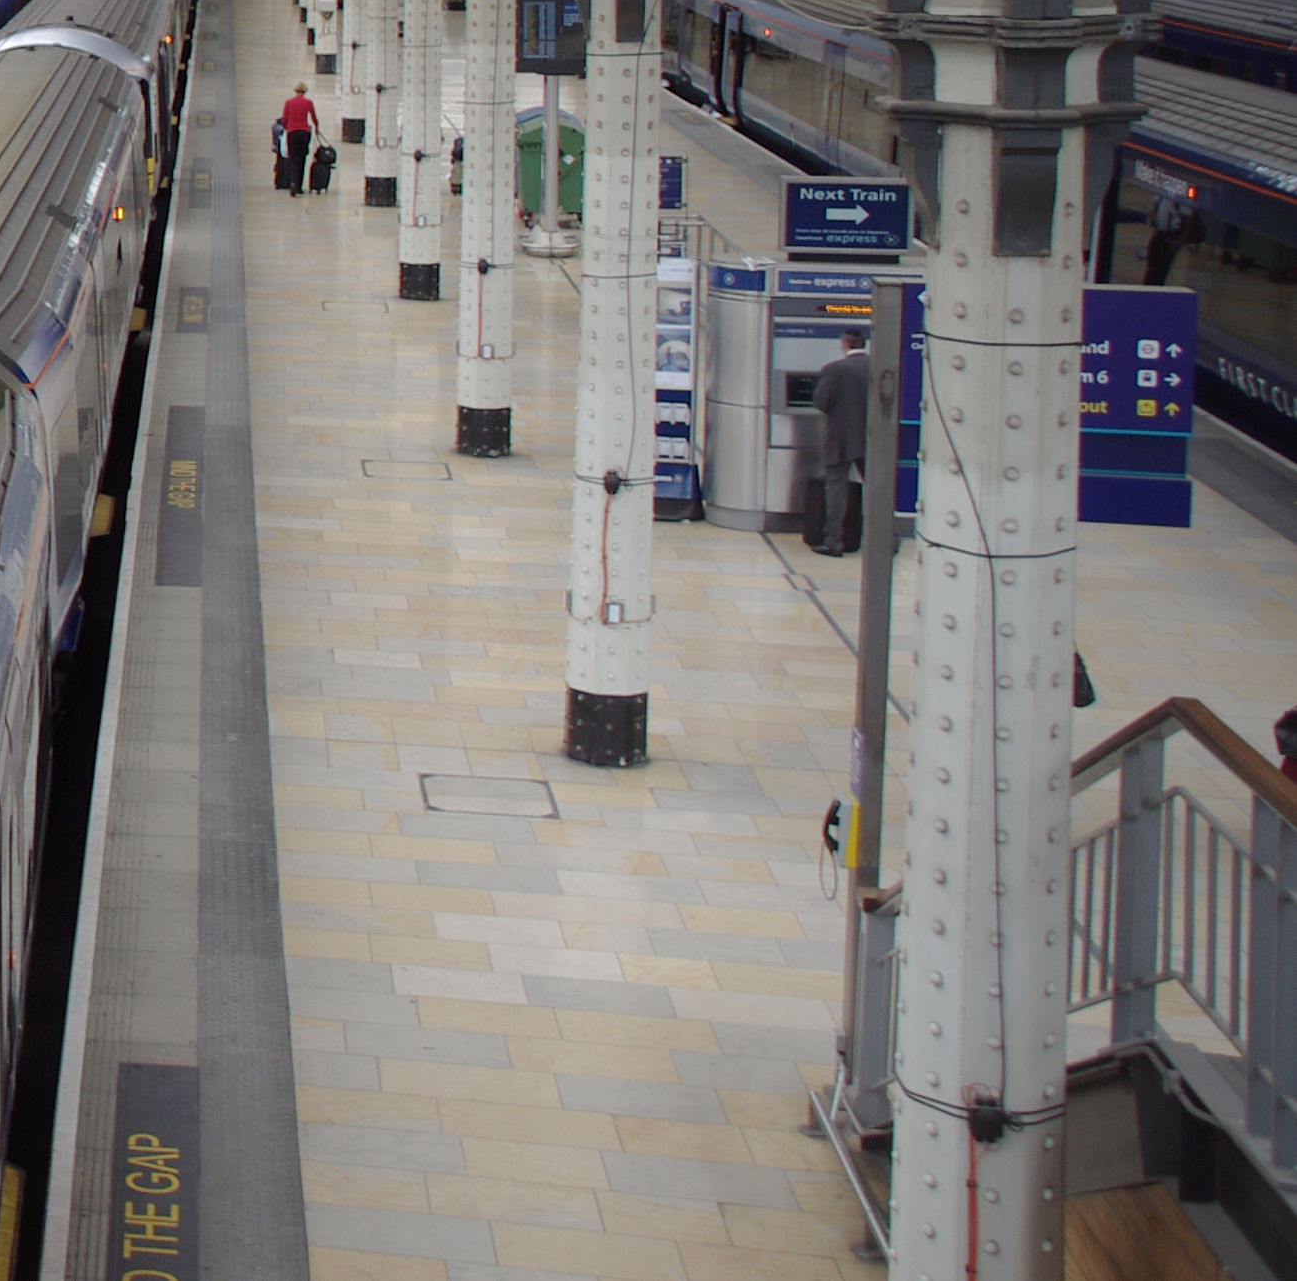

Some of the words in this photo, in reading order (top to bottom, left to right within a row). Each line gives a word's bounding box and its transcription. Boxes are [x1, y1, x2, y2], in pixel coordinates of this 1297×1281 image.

[800, 188, 845, 201] Next
[850, 188, 897, 201] Train
[826, 234, 877, 245] express
[1097, 370, 1109, 384] 6
[1218, 357, 1268, 404] FIRST
[125, 1133, 181, 1194] GAP
[122, 1201, 180, 1259] THE
